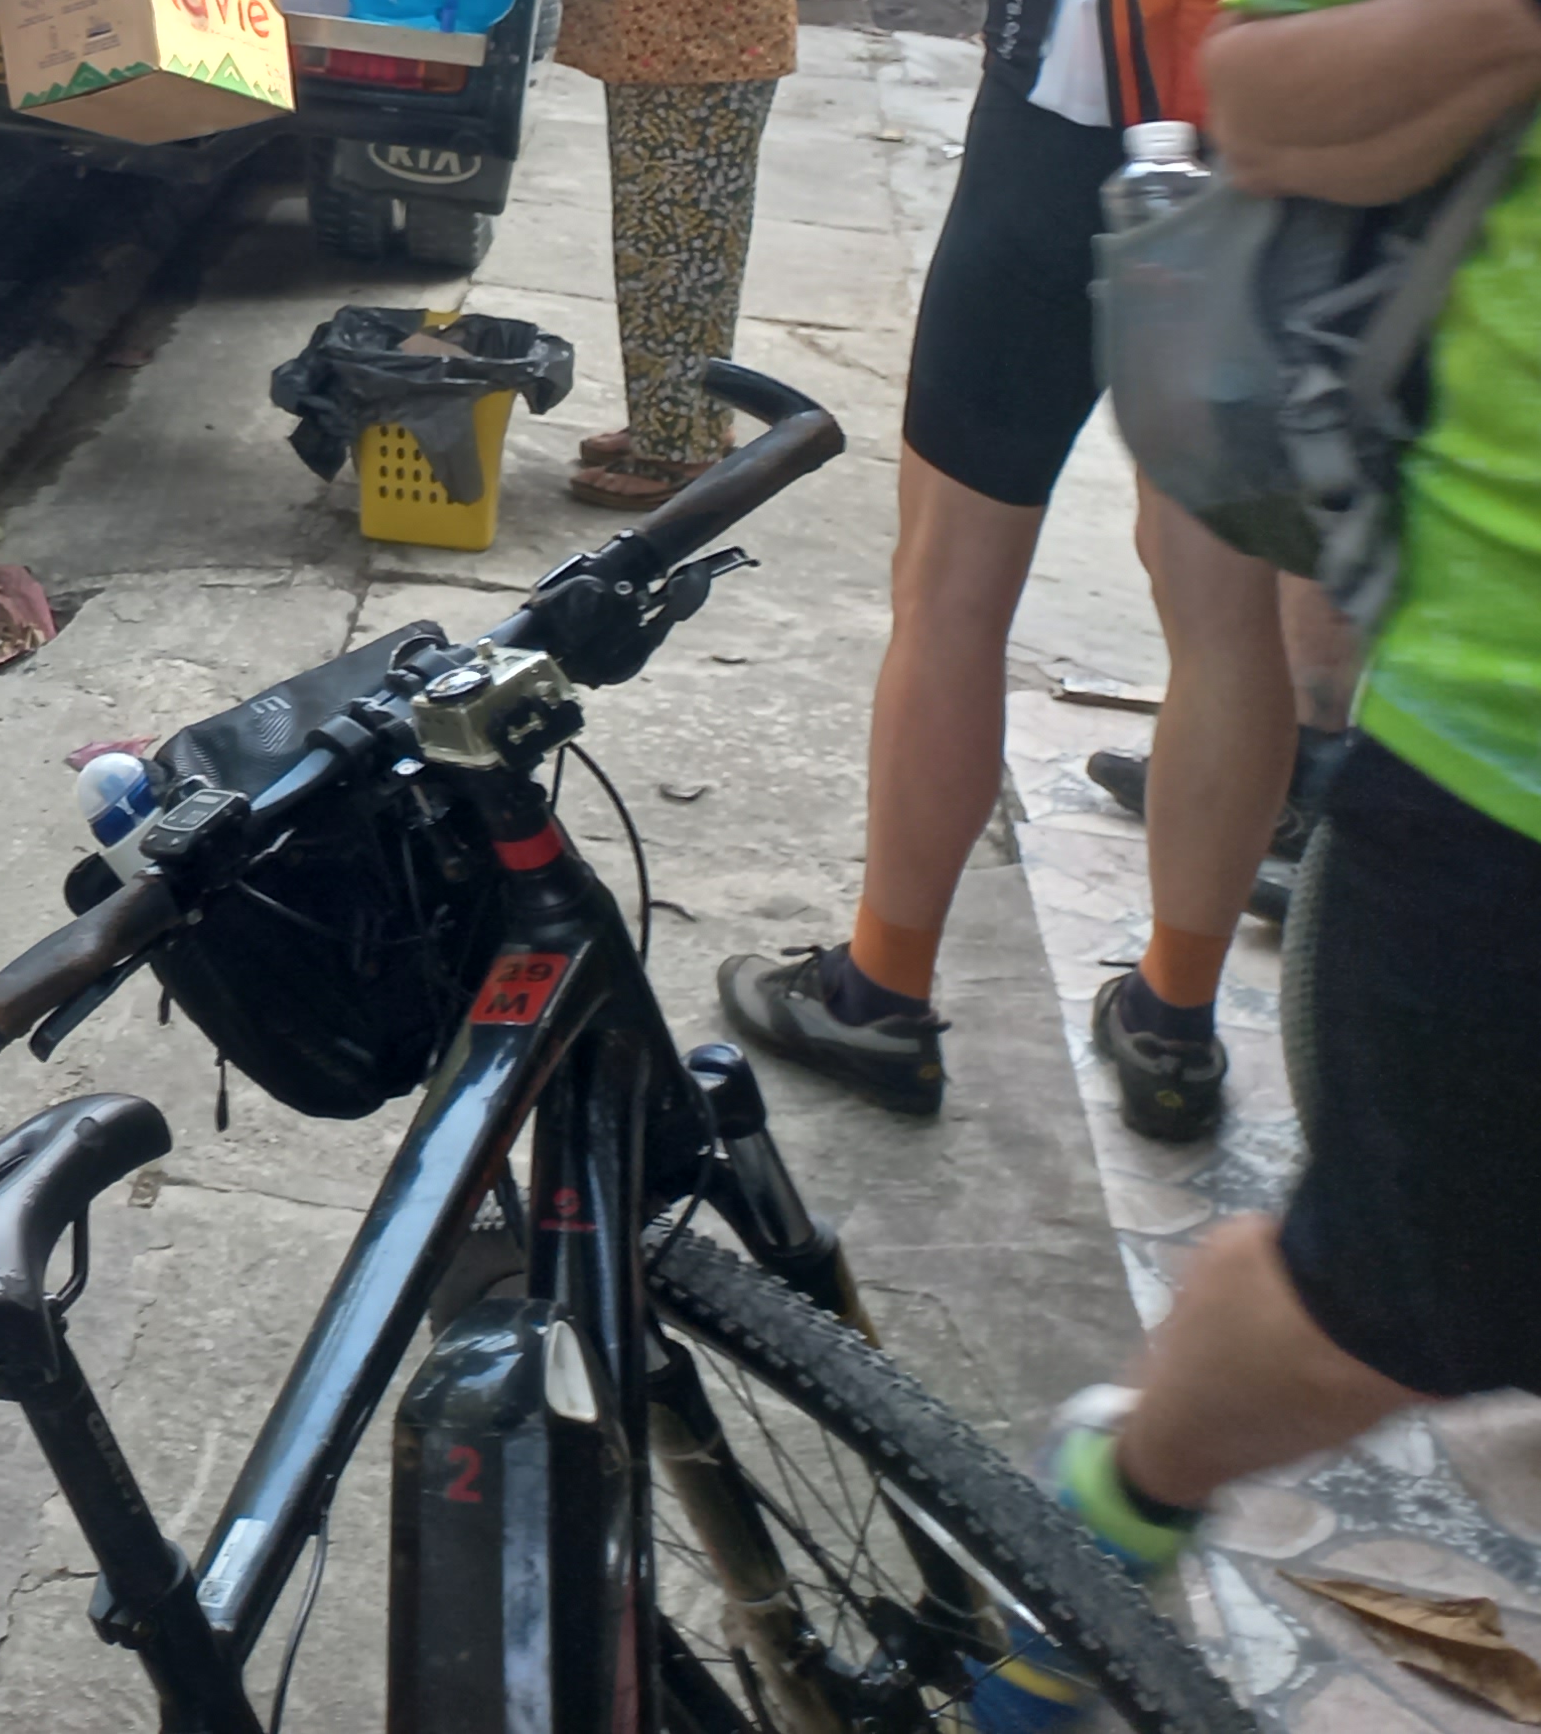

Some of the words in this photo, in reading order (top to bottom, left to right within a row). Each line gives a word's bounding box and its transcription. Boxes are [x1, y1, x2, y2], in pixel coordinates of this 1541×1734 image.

[388, 146, 462, 177] KIA
[495, 961, 554, 984] 29
[484, 991, 531, 1016] M
[446, 1445, 484, 1504] 2
